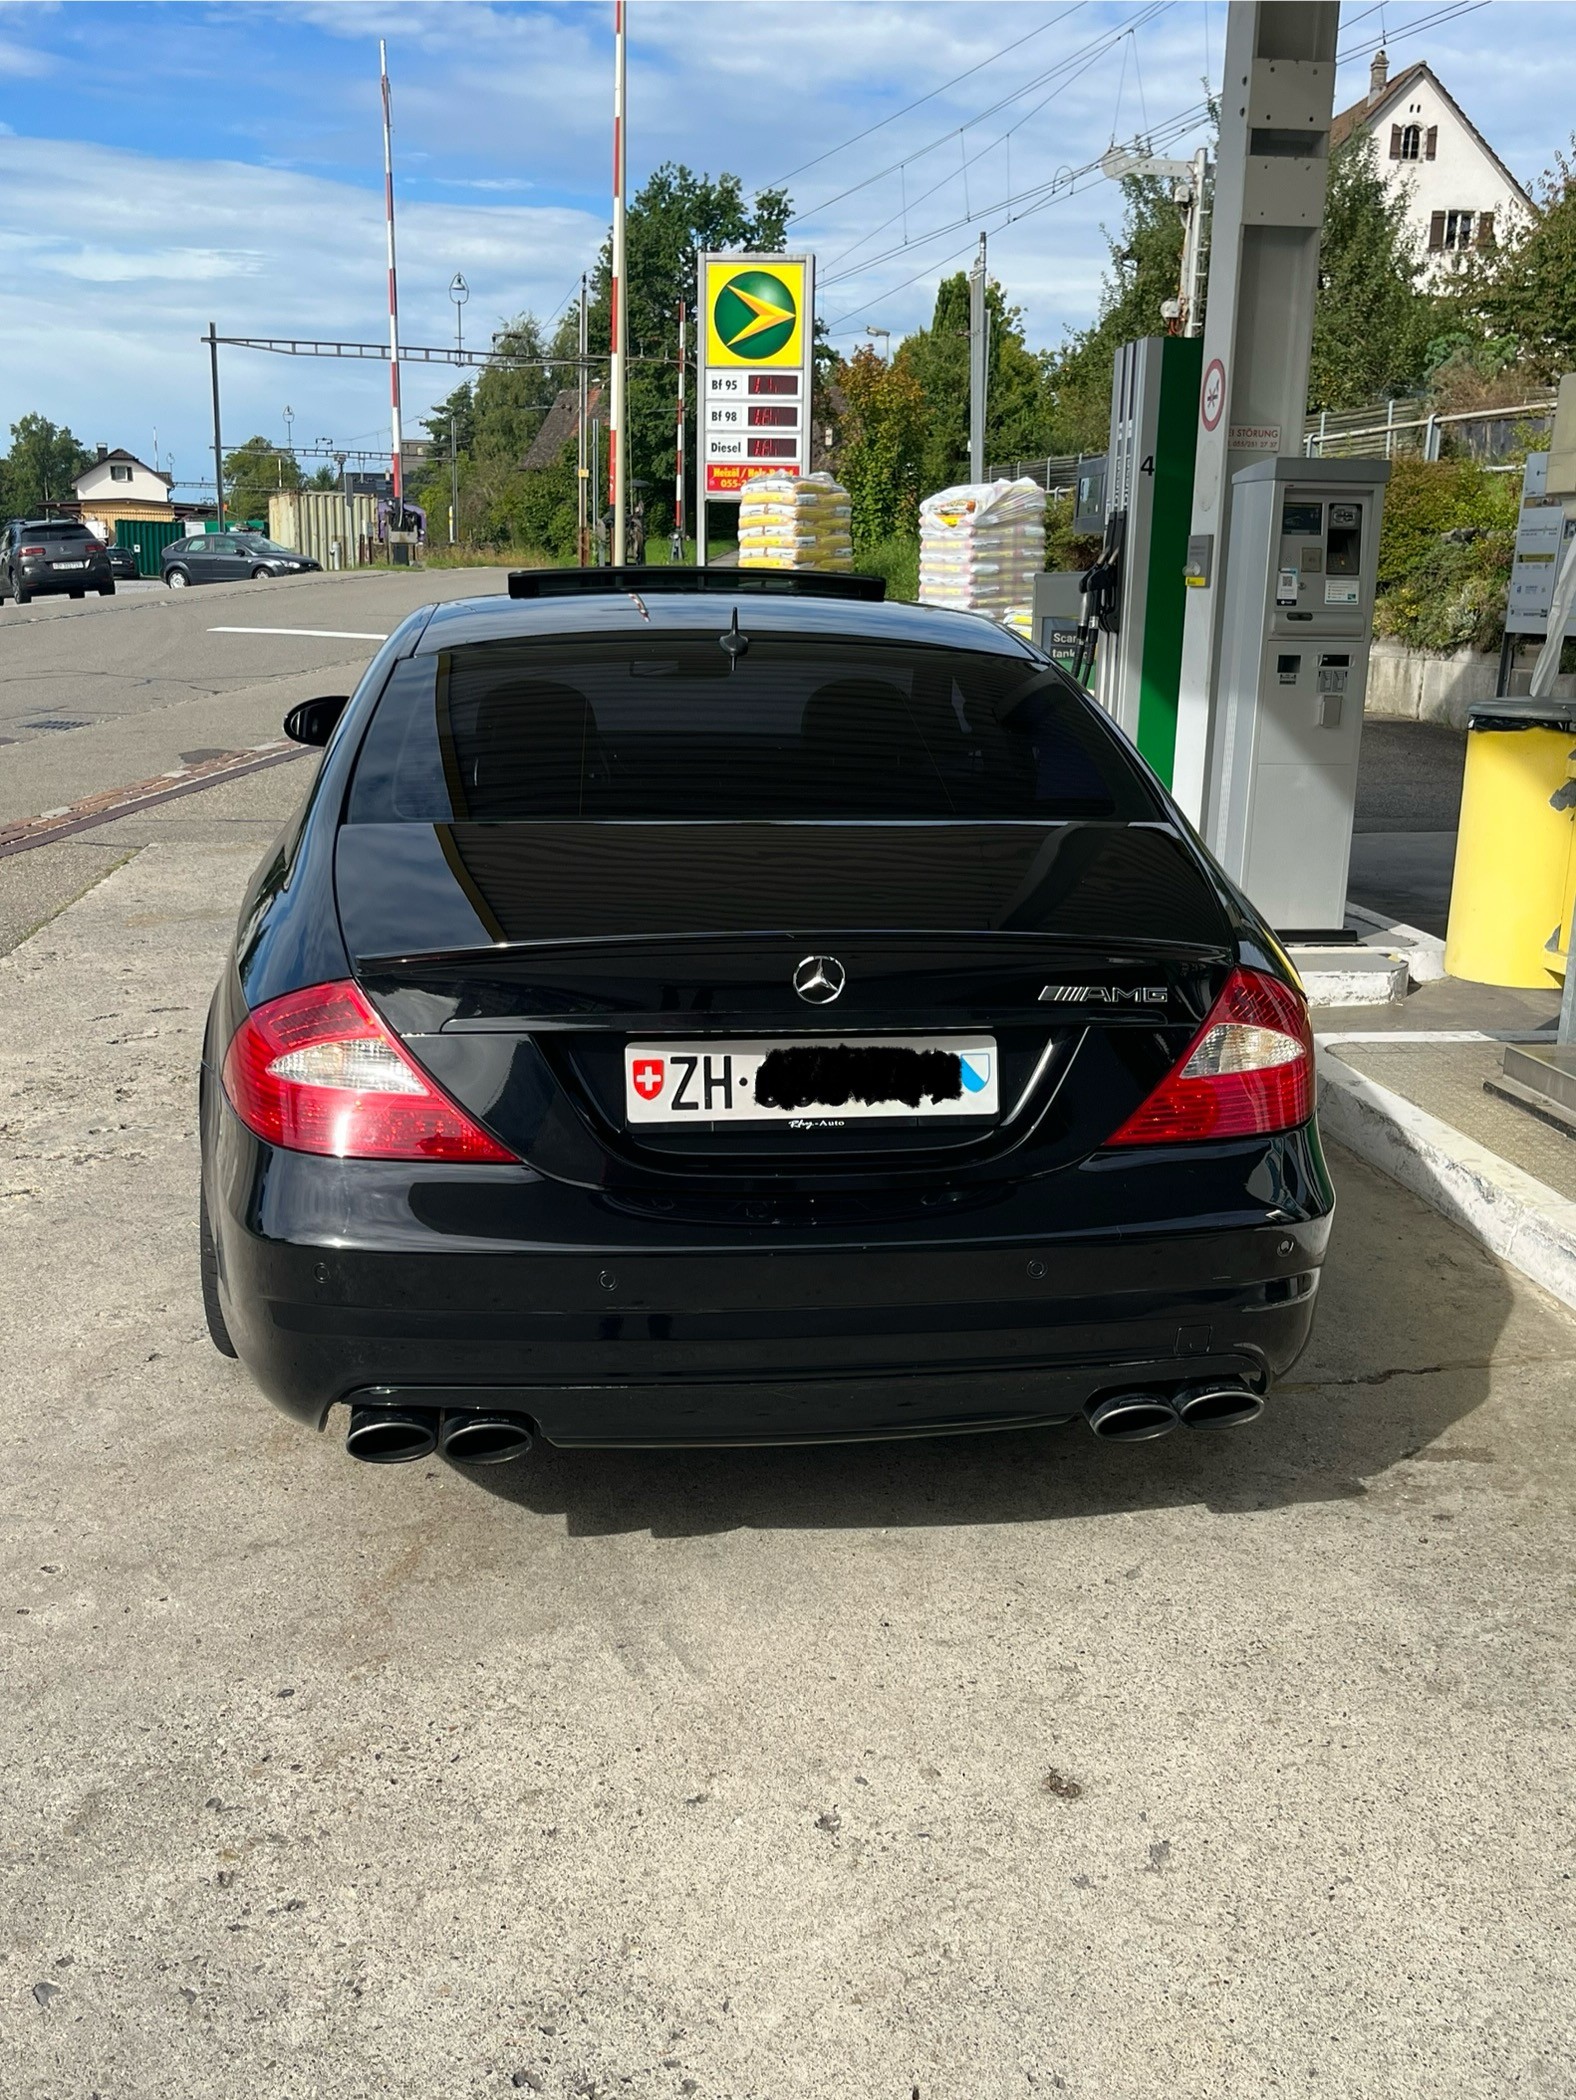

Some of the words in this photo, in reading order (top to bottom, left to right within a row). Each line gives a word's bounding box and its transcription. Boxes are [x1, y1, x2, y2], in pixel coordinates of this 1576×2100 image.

[711, 379, 722, 391] Bf
[725, 379, 738, 391] 95
[711, 410, 722, 422] Bf
[725, 410, 738, 422] 98
[1236, 427, 1279, 438] STÖRUNG
[711, 441, 742, 453] Diesel
[1140, 455, 1155, 476] 4
[1077, 986, 1169, 1004] AMG
